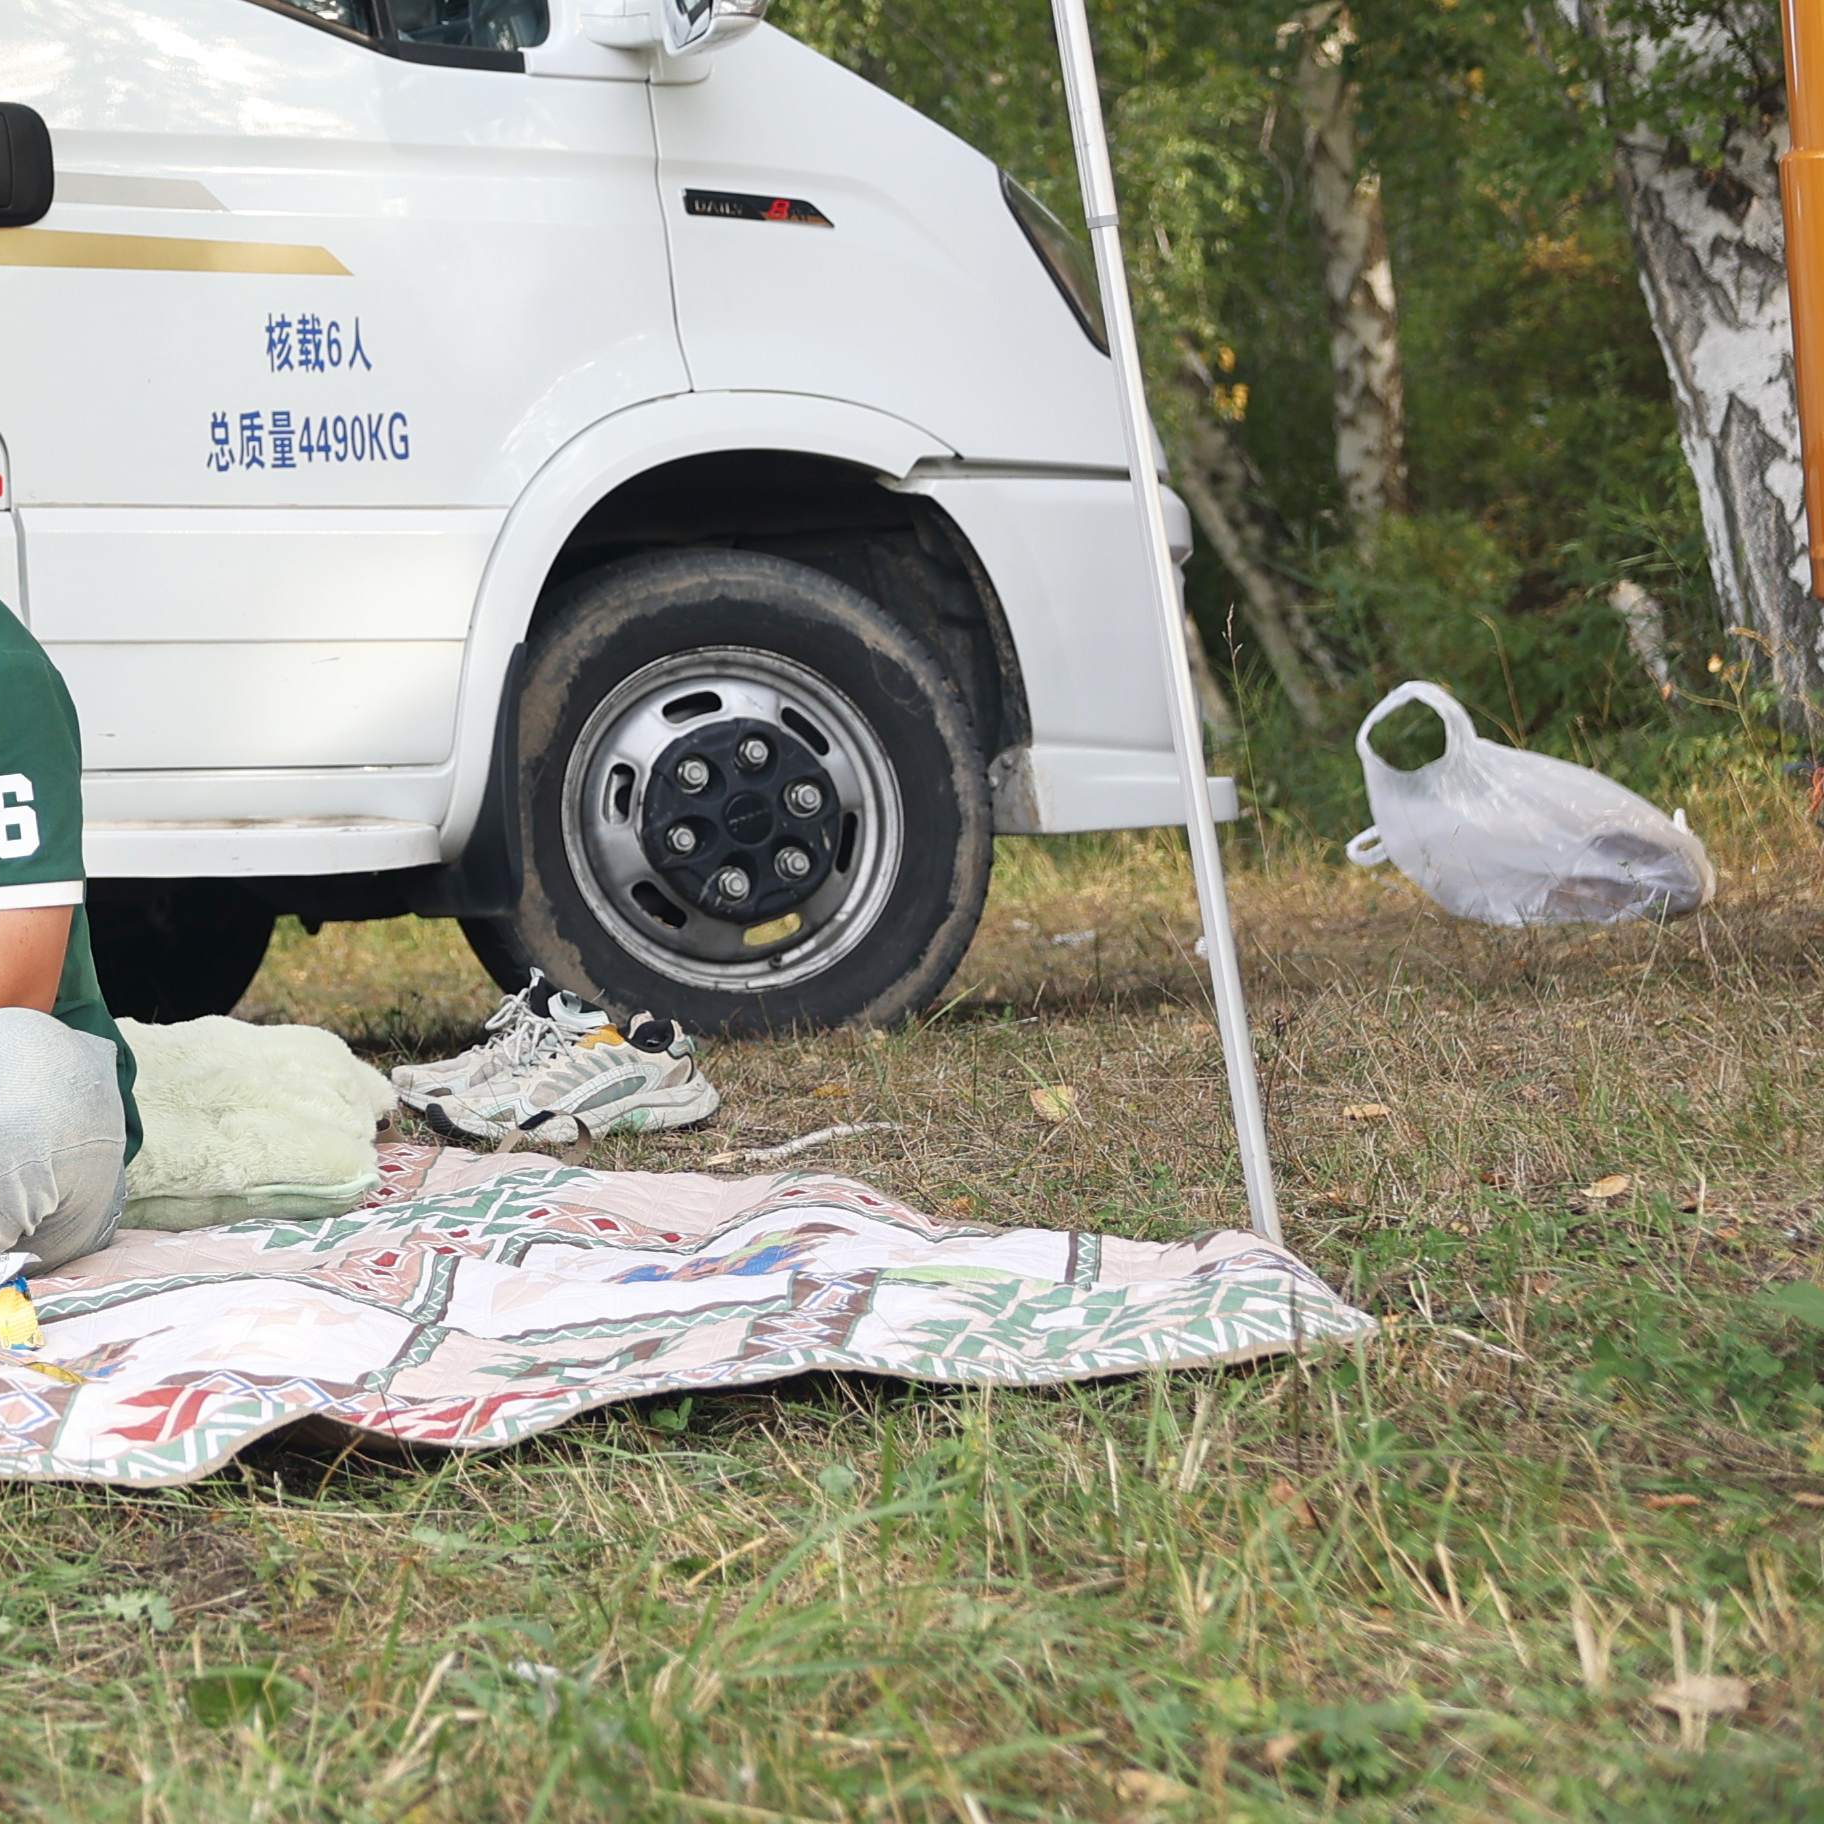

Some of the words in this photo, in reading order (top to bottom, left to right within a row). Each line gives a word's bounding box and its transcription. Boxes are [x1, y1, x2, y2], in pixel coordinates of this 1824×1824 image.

[264, 313, 373, 374] 核载6人
[206, 411, 410, 473] 总质量4490KG
